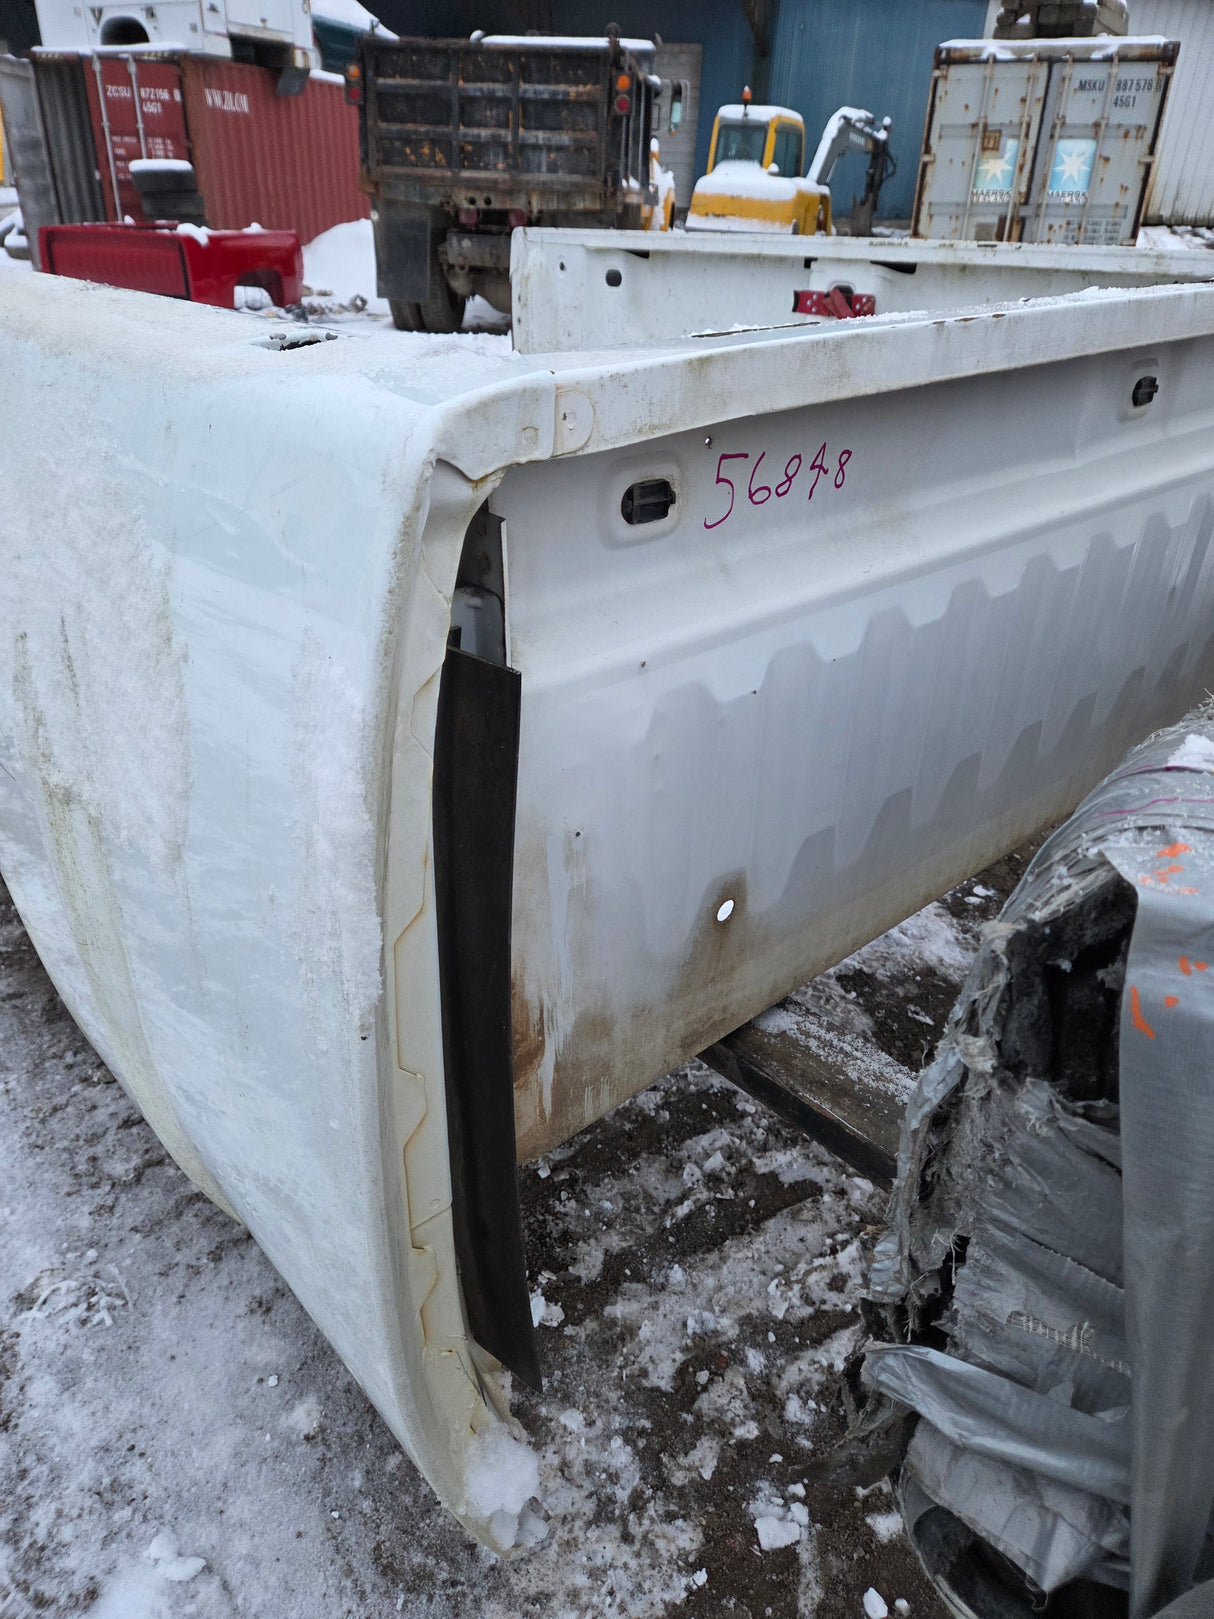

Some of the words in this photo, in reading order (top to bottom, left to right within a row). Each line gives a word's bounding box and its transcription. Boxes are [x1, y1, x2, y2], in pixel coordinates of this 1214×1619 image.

[106, 85, 131, 98] ZCSU
[1078, 78, 1105, 92] MSKU
[703, 441, 852, 530] 56848
